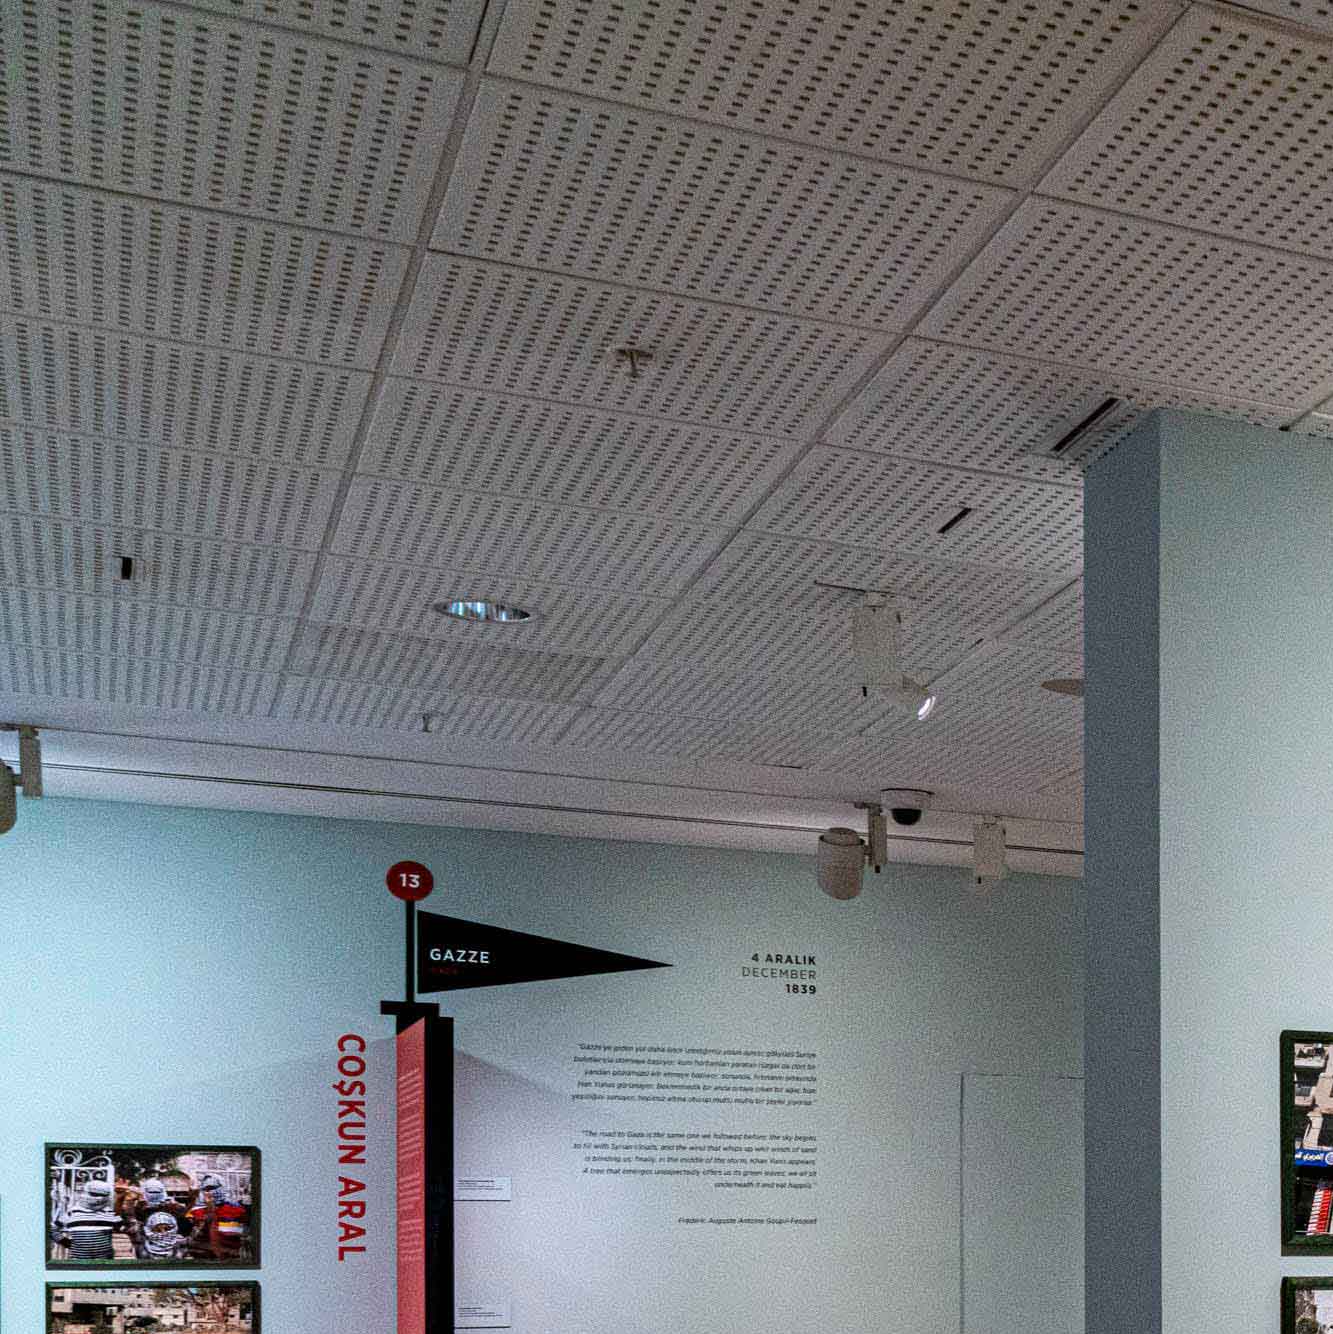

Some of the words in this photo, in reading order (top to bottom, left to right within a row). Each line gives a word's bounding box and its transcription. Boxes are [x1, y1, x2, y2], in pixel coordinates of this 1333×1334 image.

[400, 873, 420, 888] 13
[431, 948, 489, 964] GAZZE
[751, 952, 760, 963] 4
[765, 953, 816, 966] ARALIK
[741, 966, 817, 980] DECEMBER
[785, 983, 817, 994] 1839
[333, 1034, 366, 1165] COŞKUN
[337, 1177, 366, 1262] ARAL
